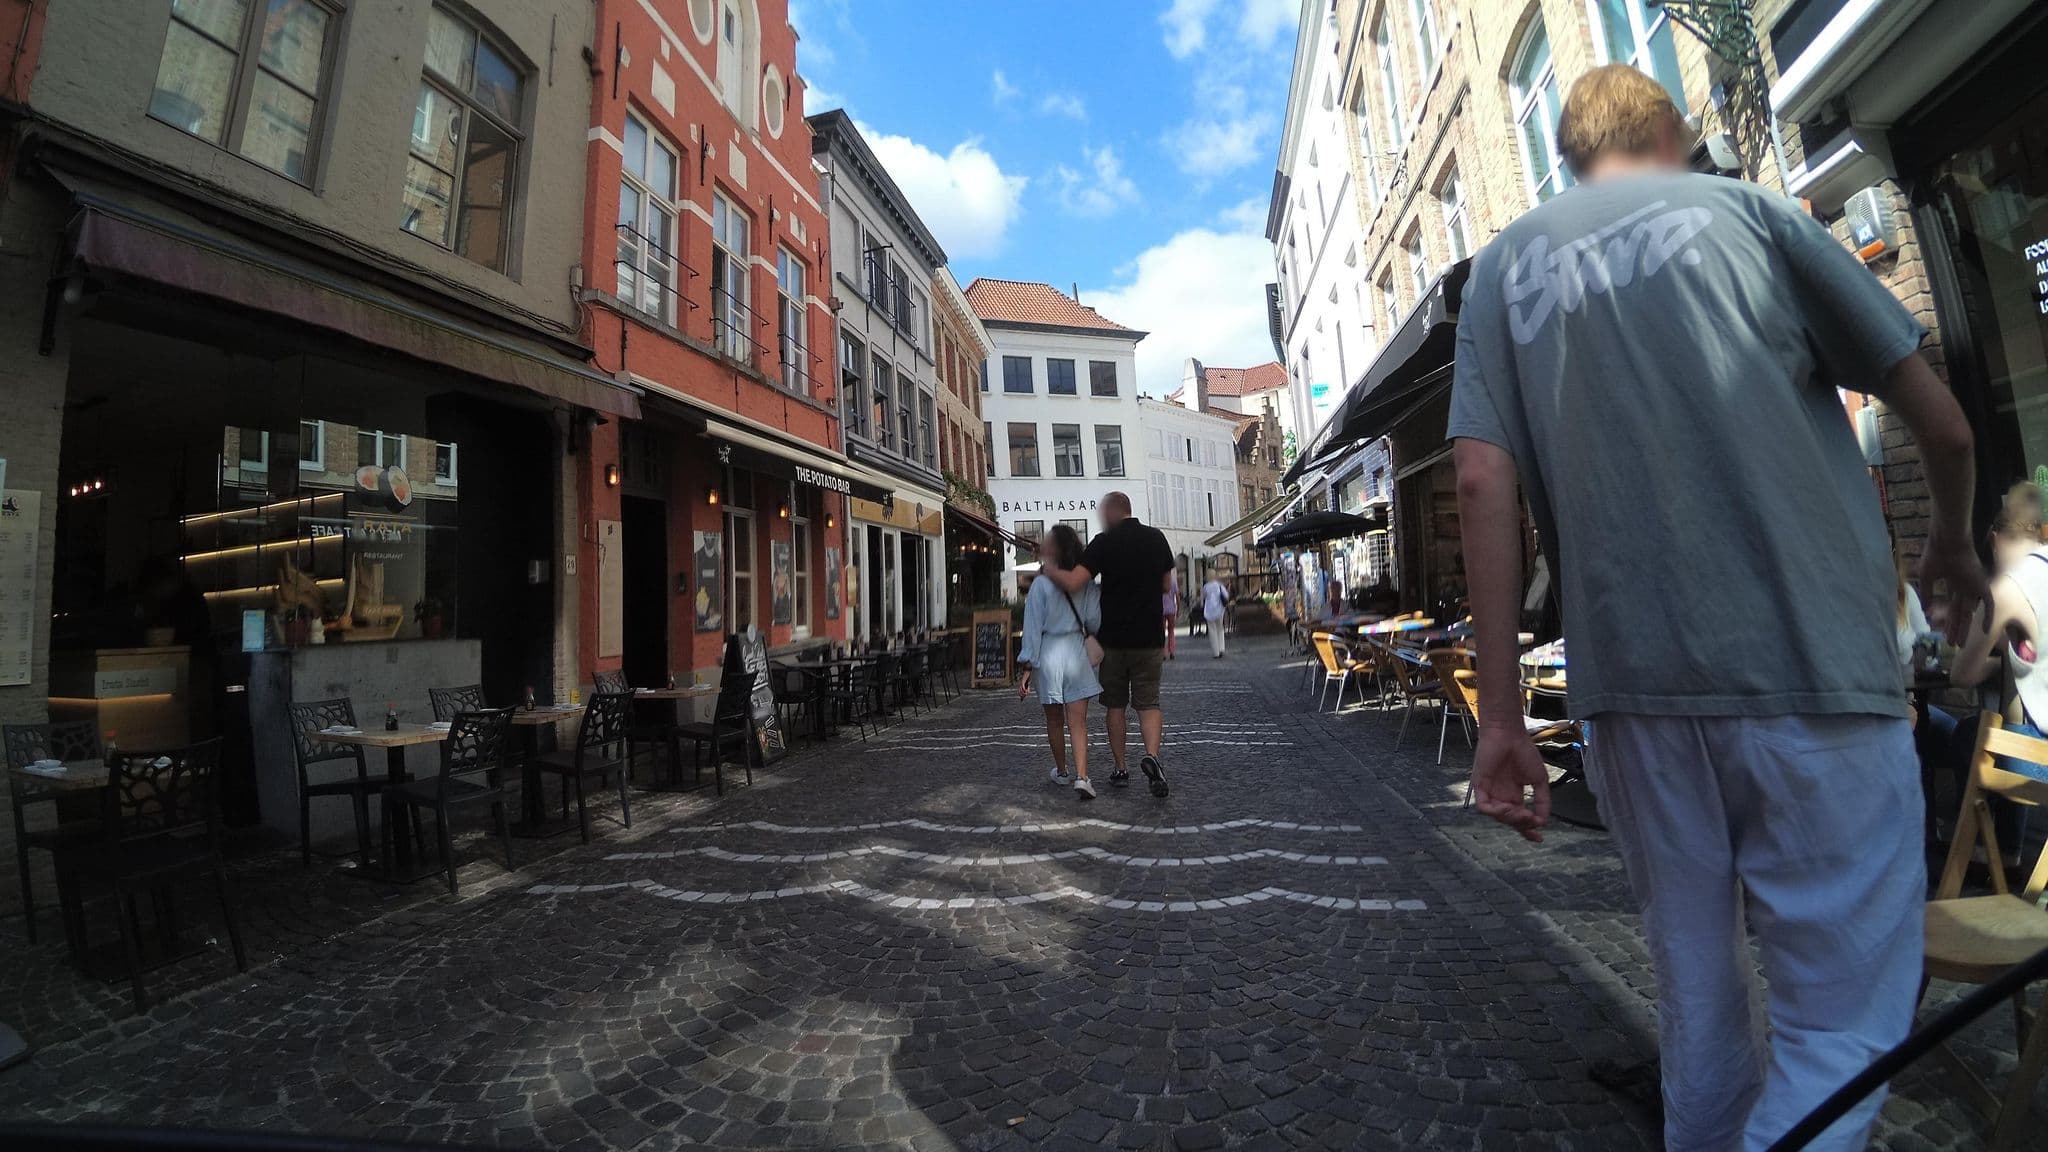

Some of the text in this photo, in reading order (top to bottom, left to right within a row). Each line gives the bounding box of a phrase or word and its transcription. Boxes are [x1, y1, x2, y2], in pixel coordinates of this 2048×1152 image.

[2036, 259, 2048, 276] AL
[2038, 280, 2048, 295] D
[795, 465, 852, 494] THE POTATO BAR
[1002, 500, 1097, 512] BALTHASAR
